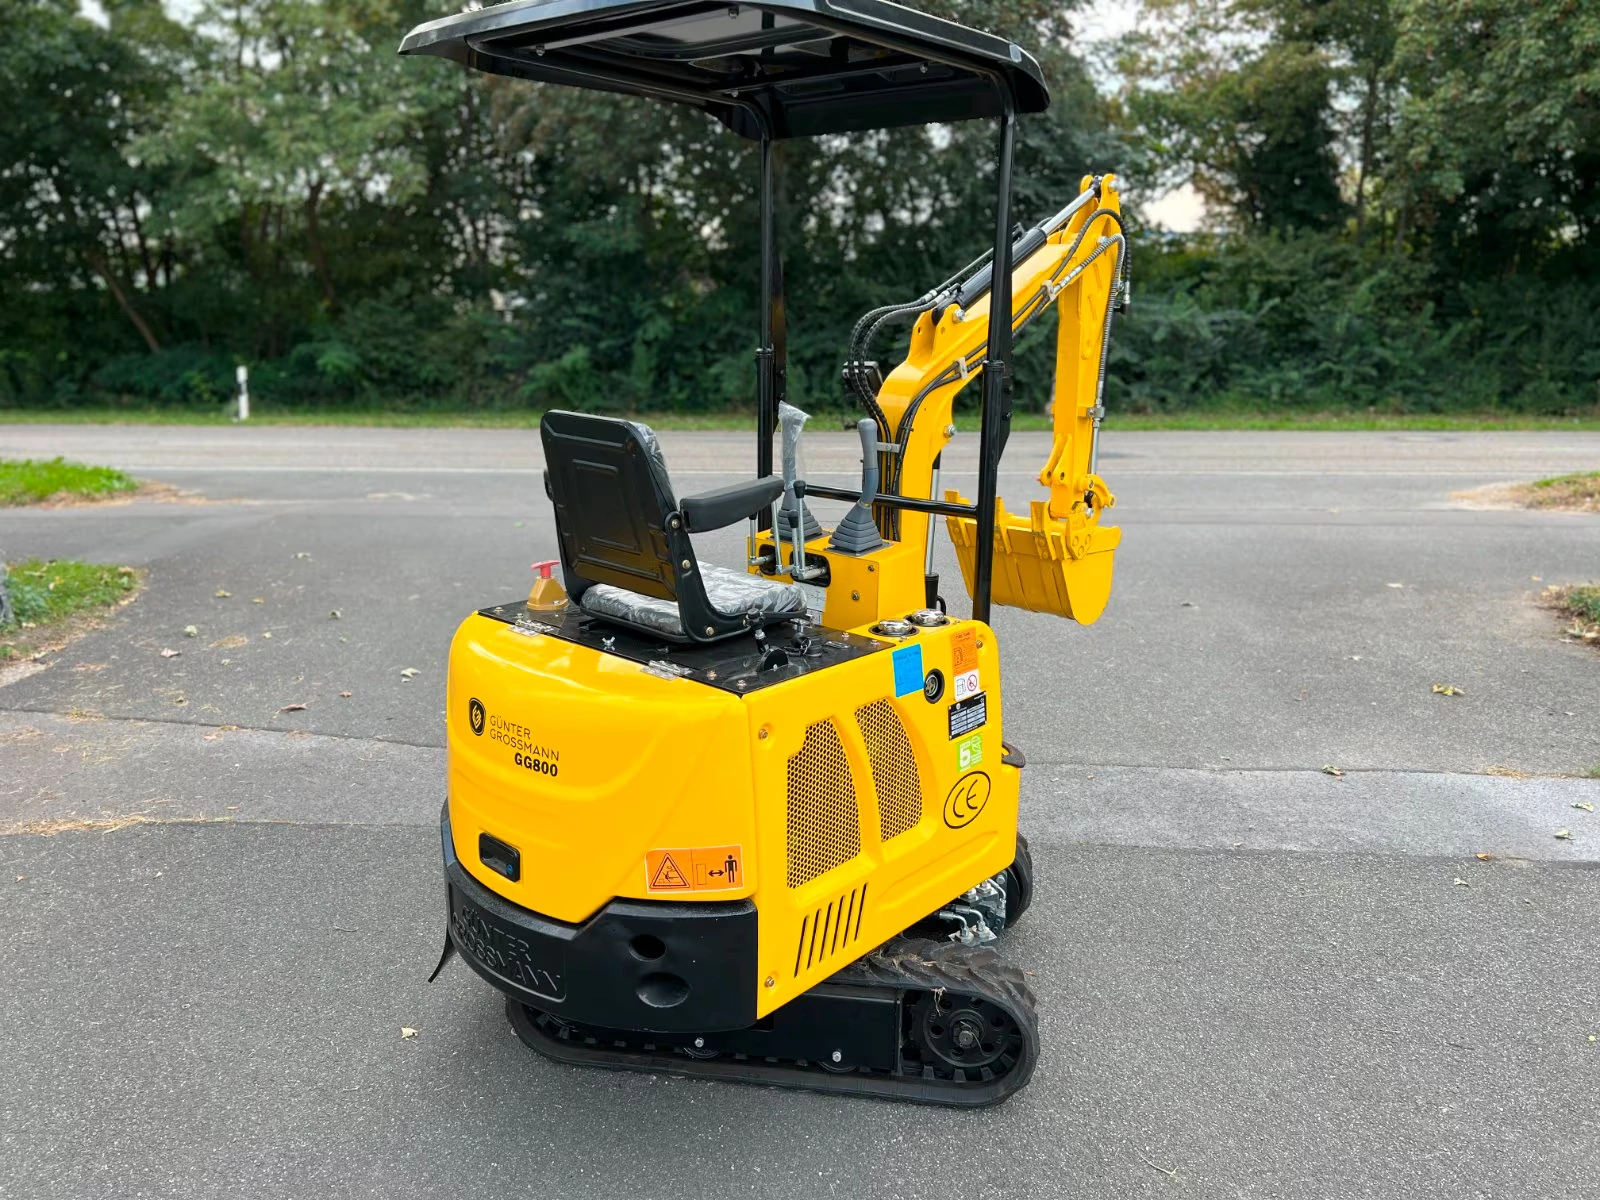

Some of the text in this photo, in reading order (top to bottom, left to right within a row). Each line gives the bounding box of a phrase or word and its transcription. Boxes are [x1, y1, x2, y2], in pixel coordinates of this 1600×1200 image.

[489, 714, 531, 740] GÜNTER
[489, 728, 559, 762] GROSSMANN
[514, 752, 558, 777] GG800
